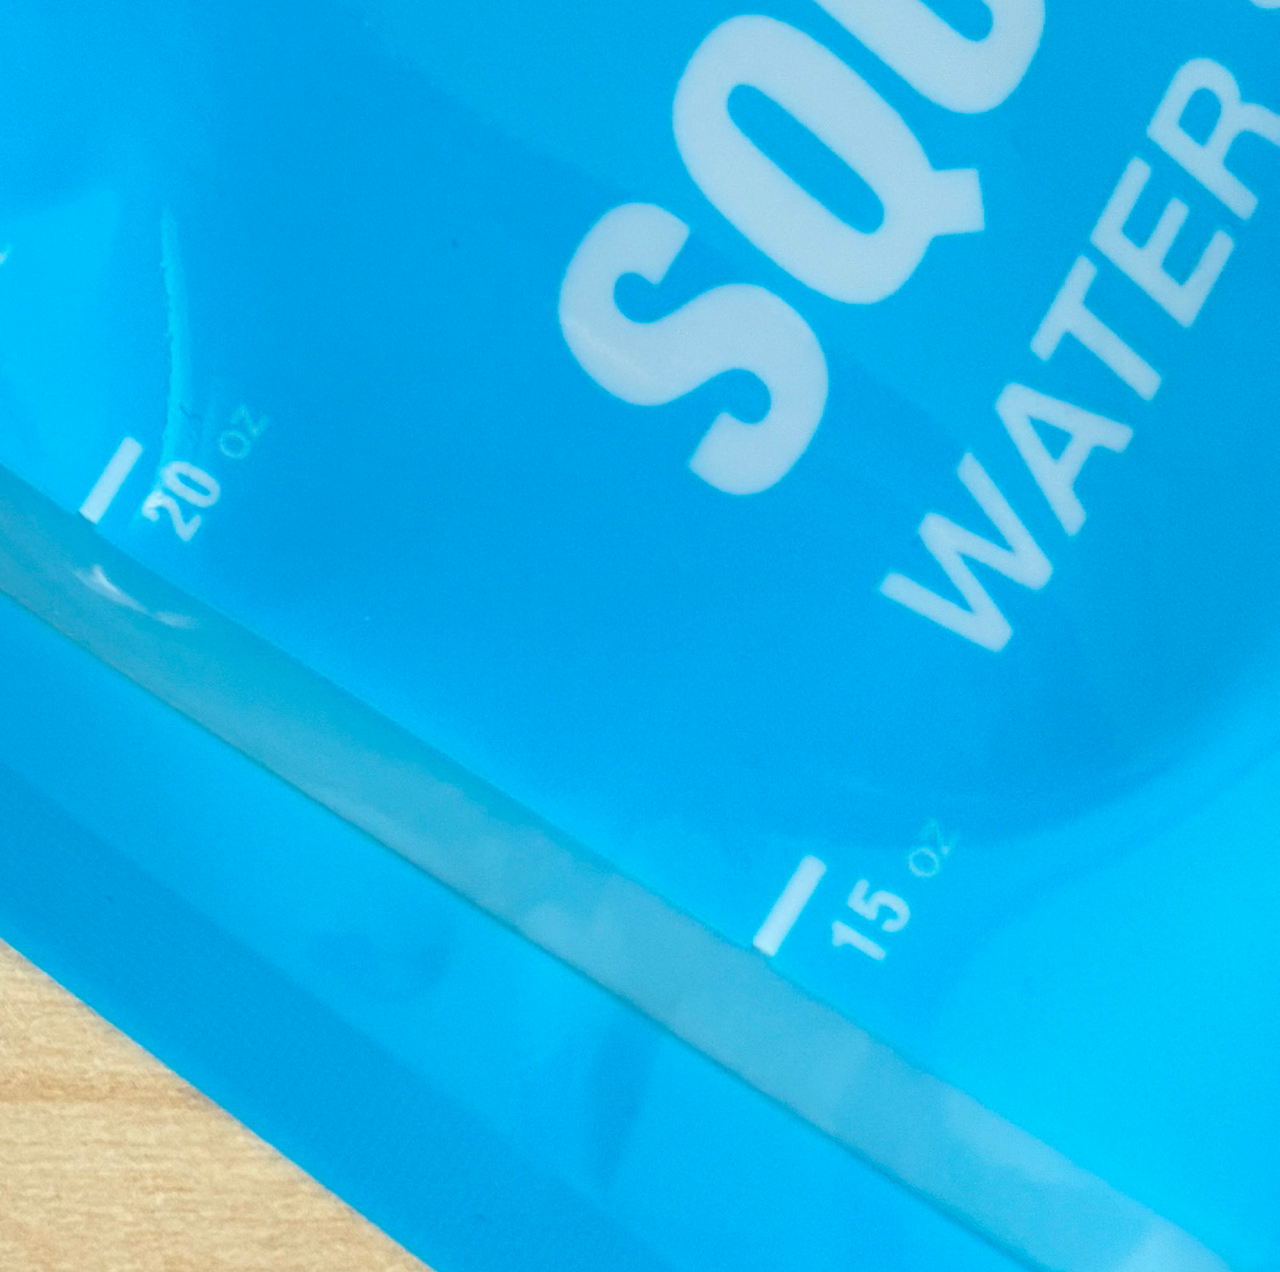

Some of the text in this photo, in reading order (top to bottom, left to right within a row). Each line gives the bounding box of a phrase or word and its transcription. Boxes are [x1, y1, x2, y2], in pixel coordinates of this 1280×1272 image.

[878, 57, 1280, 654] WATER
[140, 460, 221, 542] 20
[831, 878, 911, 961] 15
